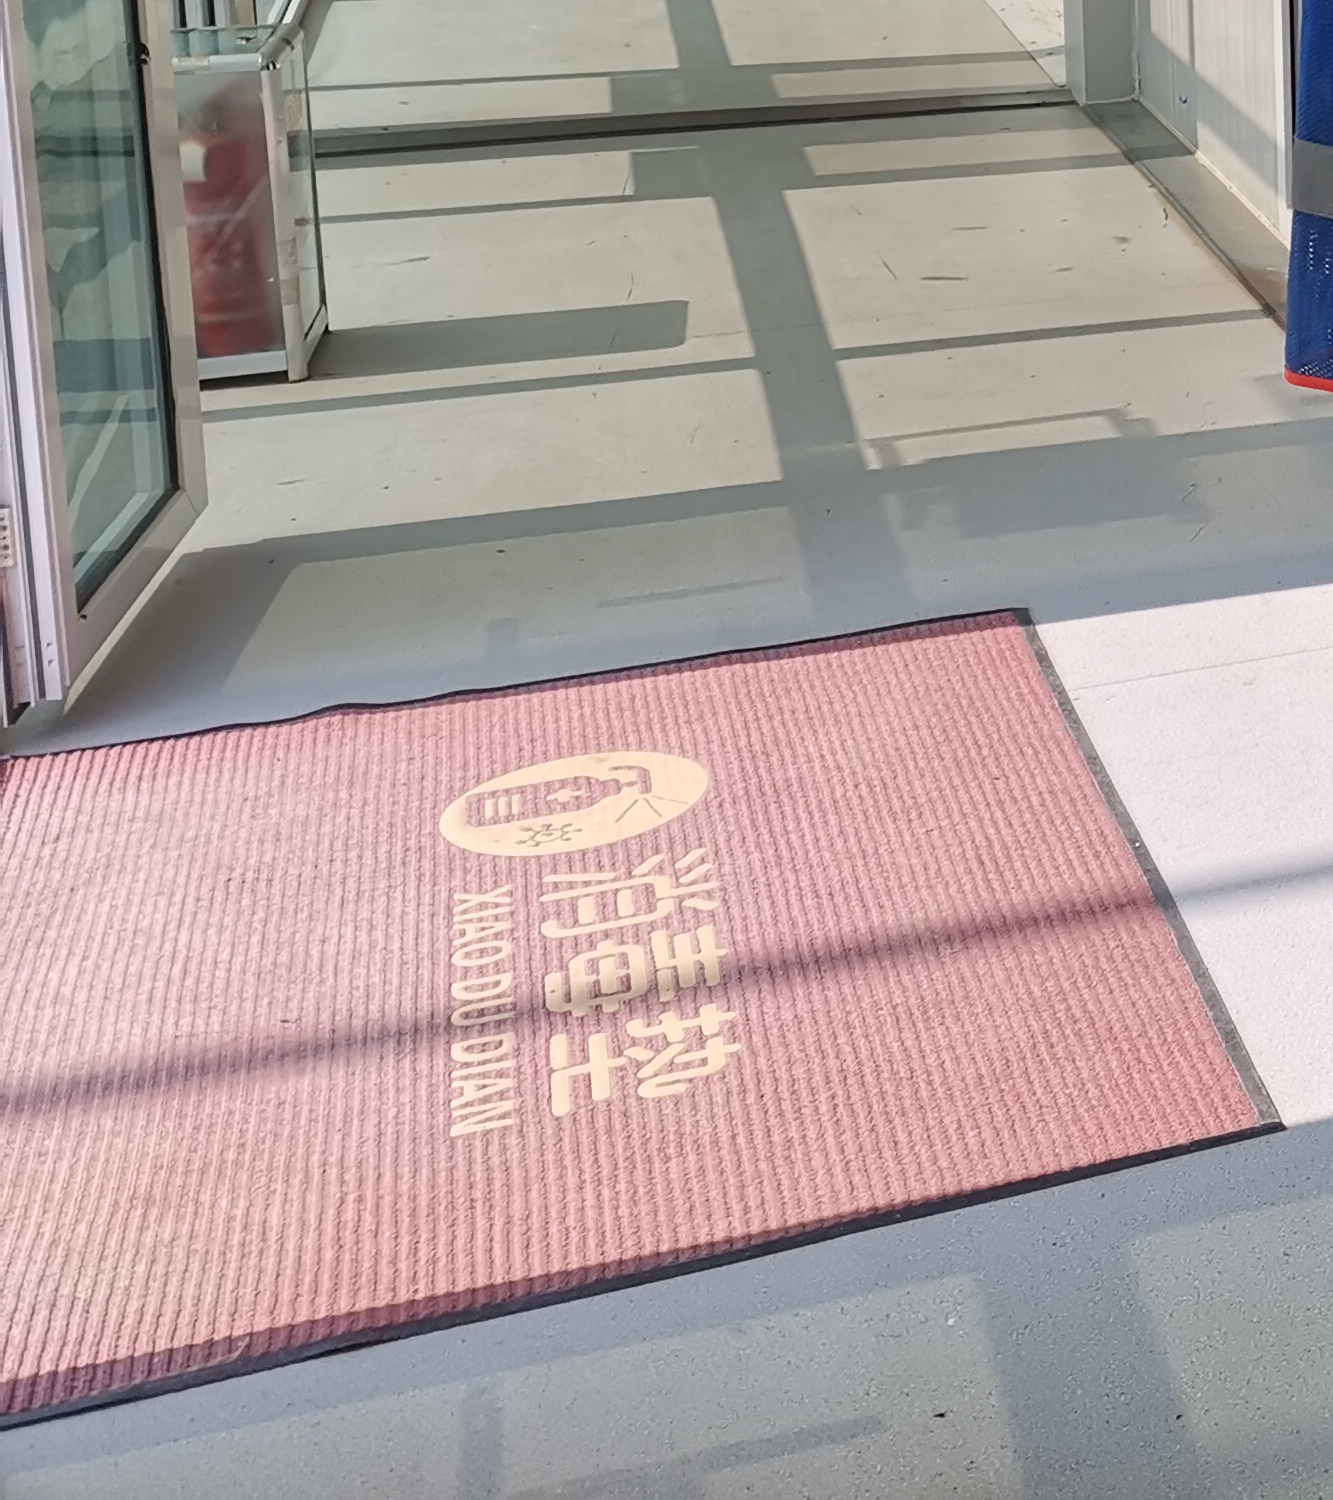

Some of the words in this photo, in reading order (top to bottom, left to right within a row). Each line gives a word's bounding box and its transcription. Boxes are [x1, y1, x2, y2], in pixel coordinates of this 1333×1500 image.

[453, 885, 512, 968] XIAO
[451, 972, 513, 1026] DU
[539, 848, 741, 1116] 消毒垫
[450, 1032, 516, 1137] DIAN
